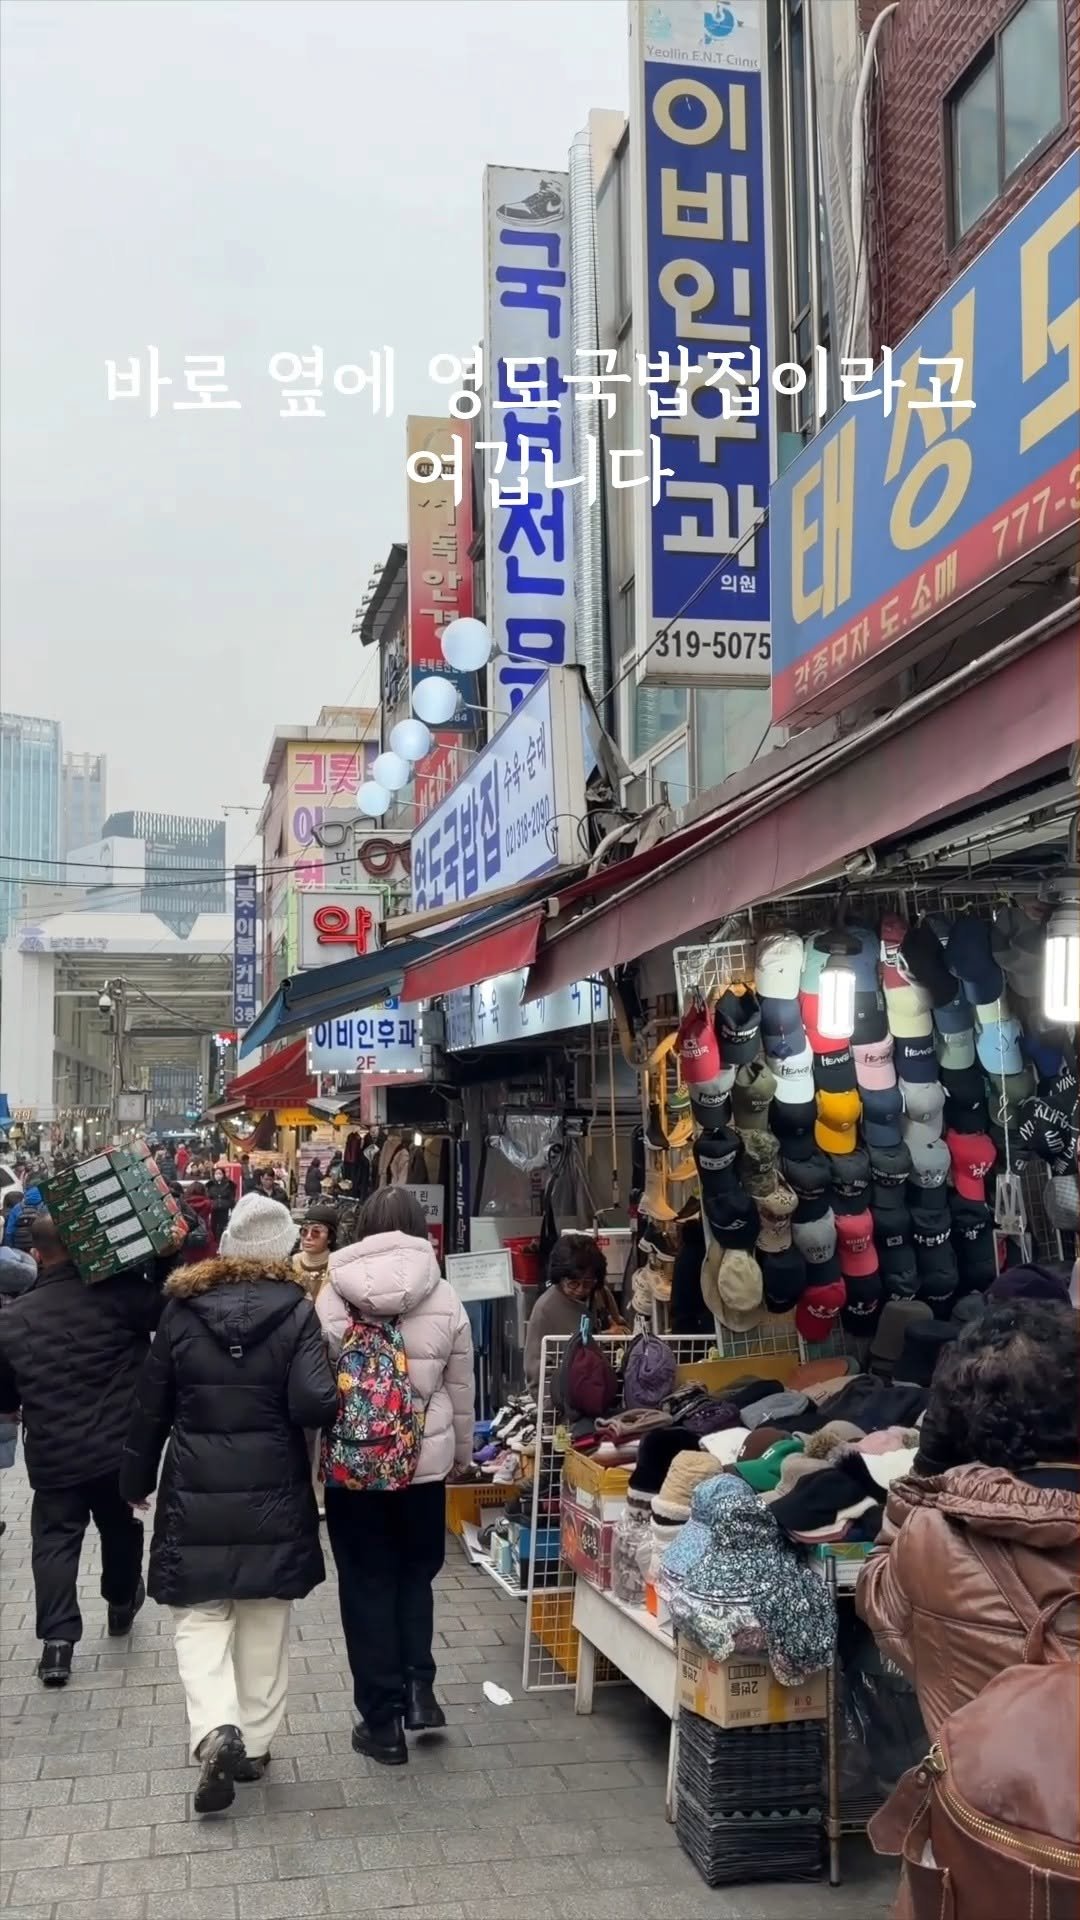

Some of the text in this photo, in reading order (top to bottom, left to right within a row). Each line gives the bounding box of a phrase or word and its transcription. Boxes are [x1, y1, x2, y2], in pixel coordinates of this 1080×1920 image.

[646, 45, 689, 60] Yeollin
[652, 78, 765, 567] 이비인후과
[721, 574, 756, 593] 의원
[655, 630, 771, 660] 319-5075
[795, 616, 871, 695] 각종모자
[294, 753, 363, 796] 그릇
[414, 758, 501, 914] 영도국밥집
[314, 905, 373, 956] 약
[314, 1019, 418, 1050] 이비인후과
[356, 1056, 376, 1070] 2F
[729, 1680, 759, 1697] 2번들
